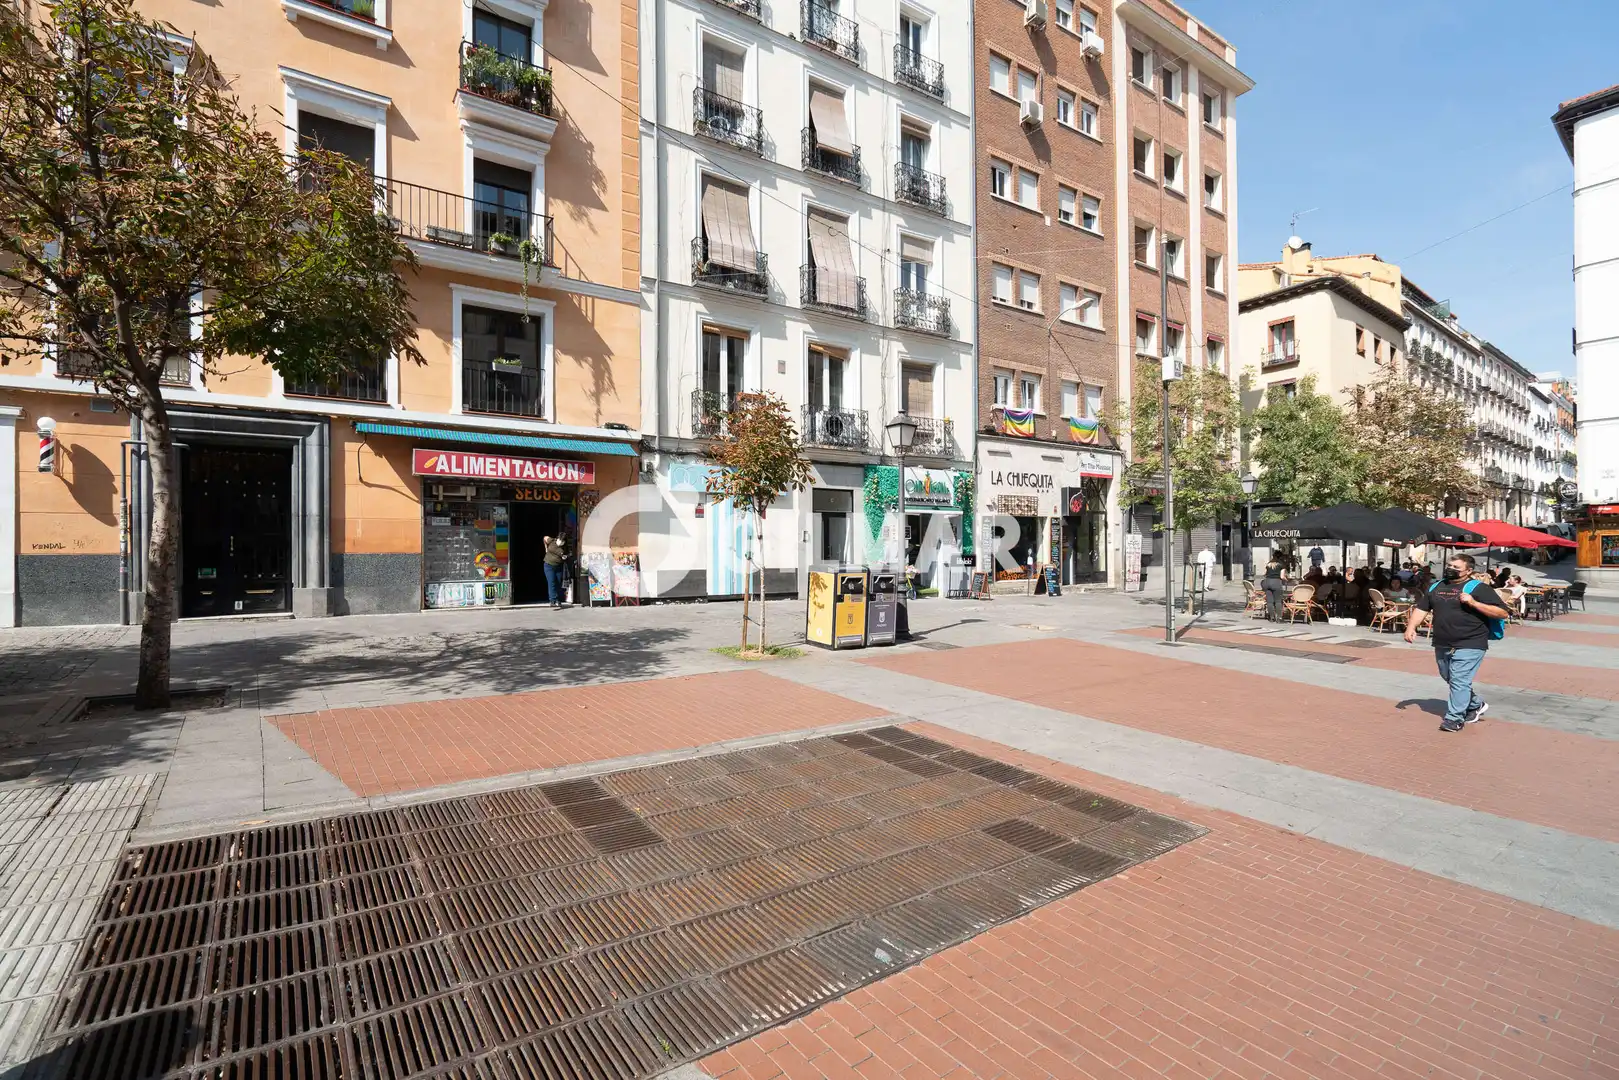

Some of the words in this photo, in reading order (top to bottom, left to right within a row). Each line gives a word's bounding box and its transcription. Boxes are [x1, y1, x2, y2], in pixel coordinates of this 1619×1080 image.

[435, 454, 579, 481] ALIMENTACION
[991, 470, 1003, 486] LA
[1006, 471, 1054, 489] CHUEQUITA
[1254, 529, 1262, 538] LA
[1263, 529, 1301, 538] CHUEQUITA
